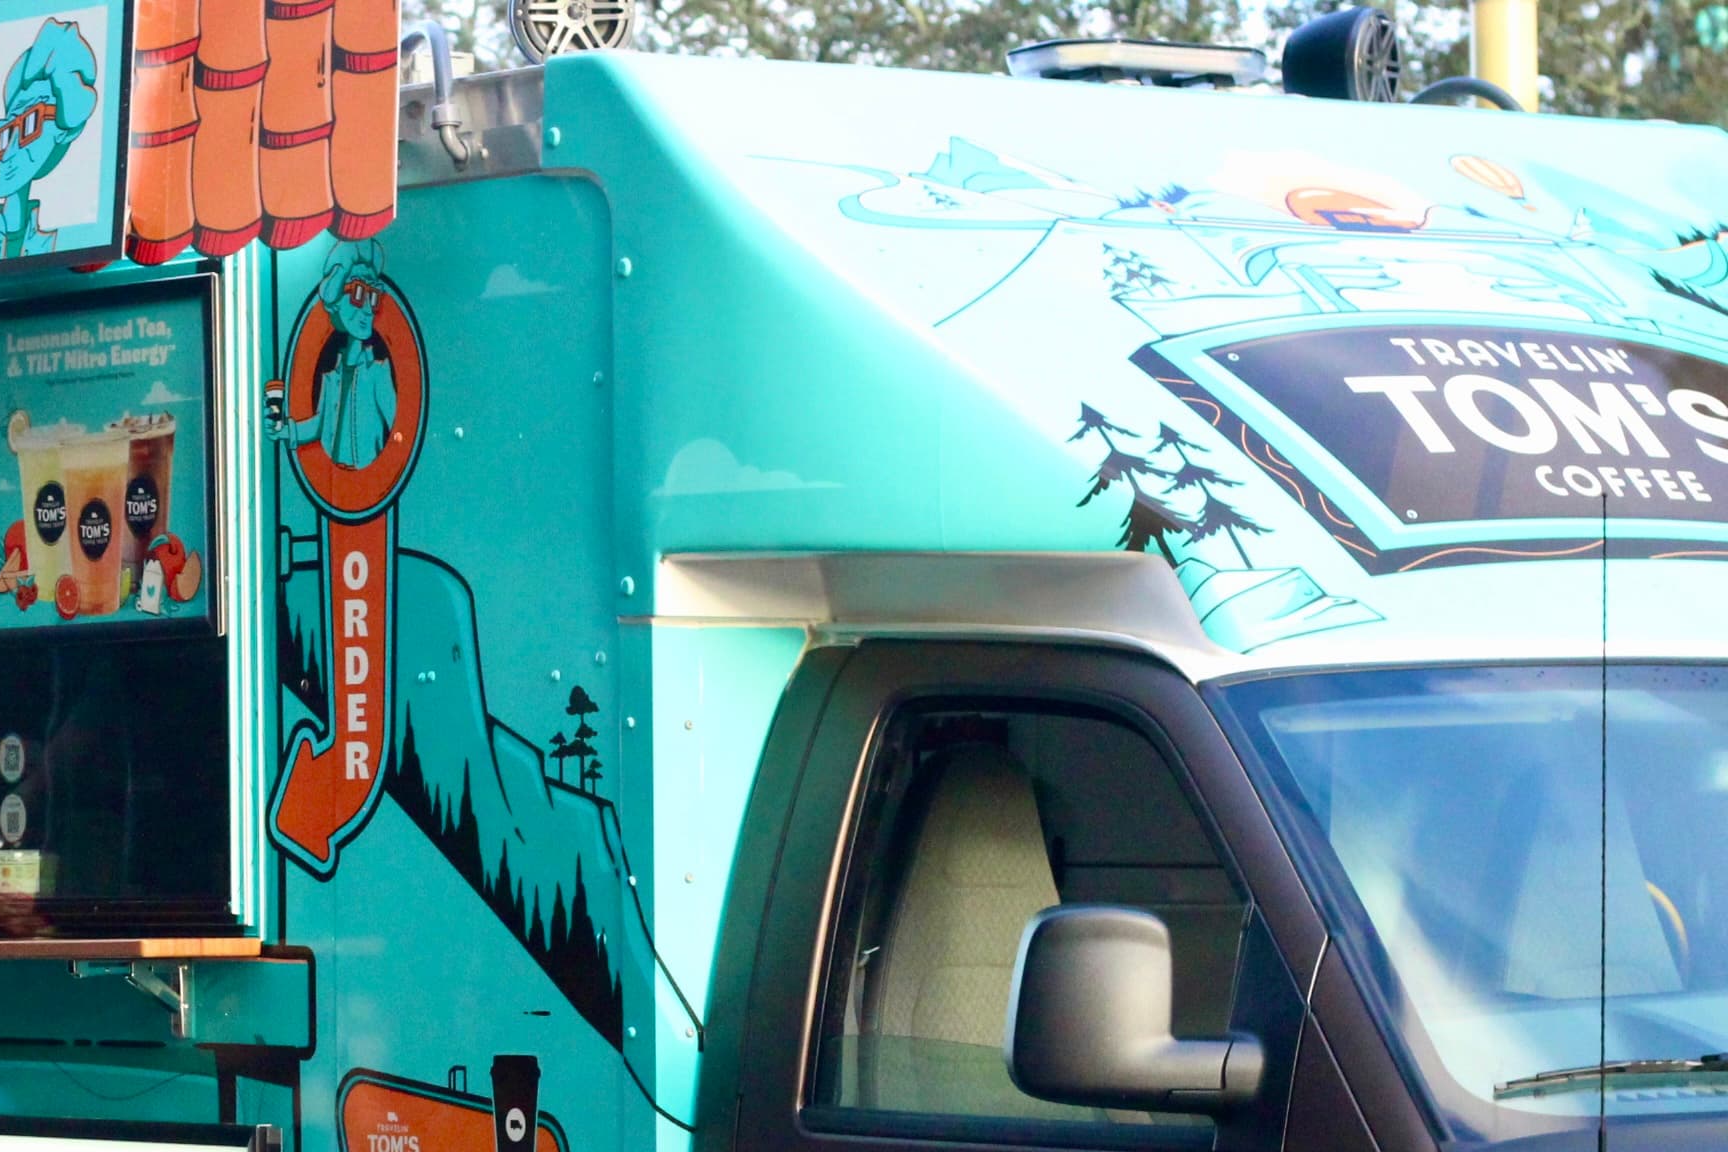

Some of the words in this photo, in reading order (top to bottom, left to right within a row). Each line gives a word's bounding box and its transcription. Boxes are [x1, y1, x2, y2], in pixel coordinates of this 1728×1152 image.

[7, 325, 95, 353] Lemonade,
[98, 319, 133, 342] Iced
[136, 316, 172, 340] Tea,
[7, 356, 22, 377] &
[26, 351, 61, 375] TILT
[64, 349, 107, 371] Nitro
[1390, 337, 1636, 376] TRAVELIN'
[1344, 374, 1728, 466] TOM'S
[1535, 465, 1712, 502] COFFEE
[36, 506, 66, 521] TOM'S
[127, 499, 157, 515] TOM'S
[80, 523, 110, 538] TOM'S
[343, 550, 370, 780] ORDER
